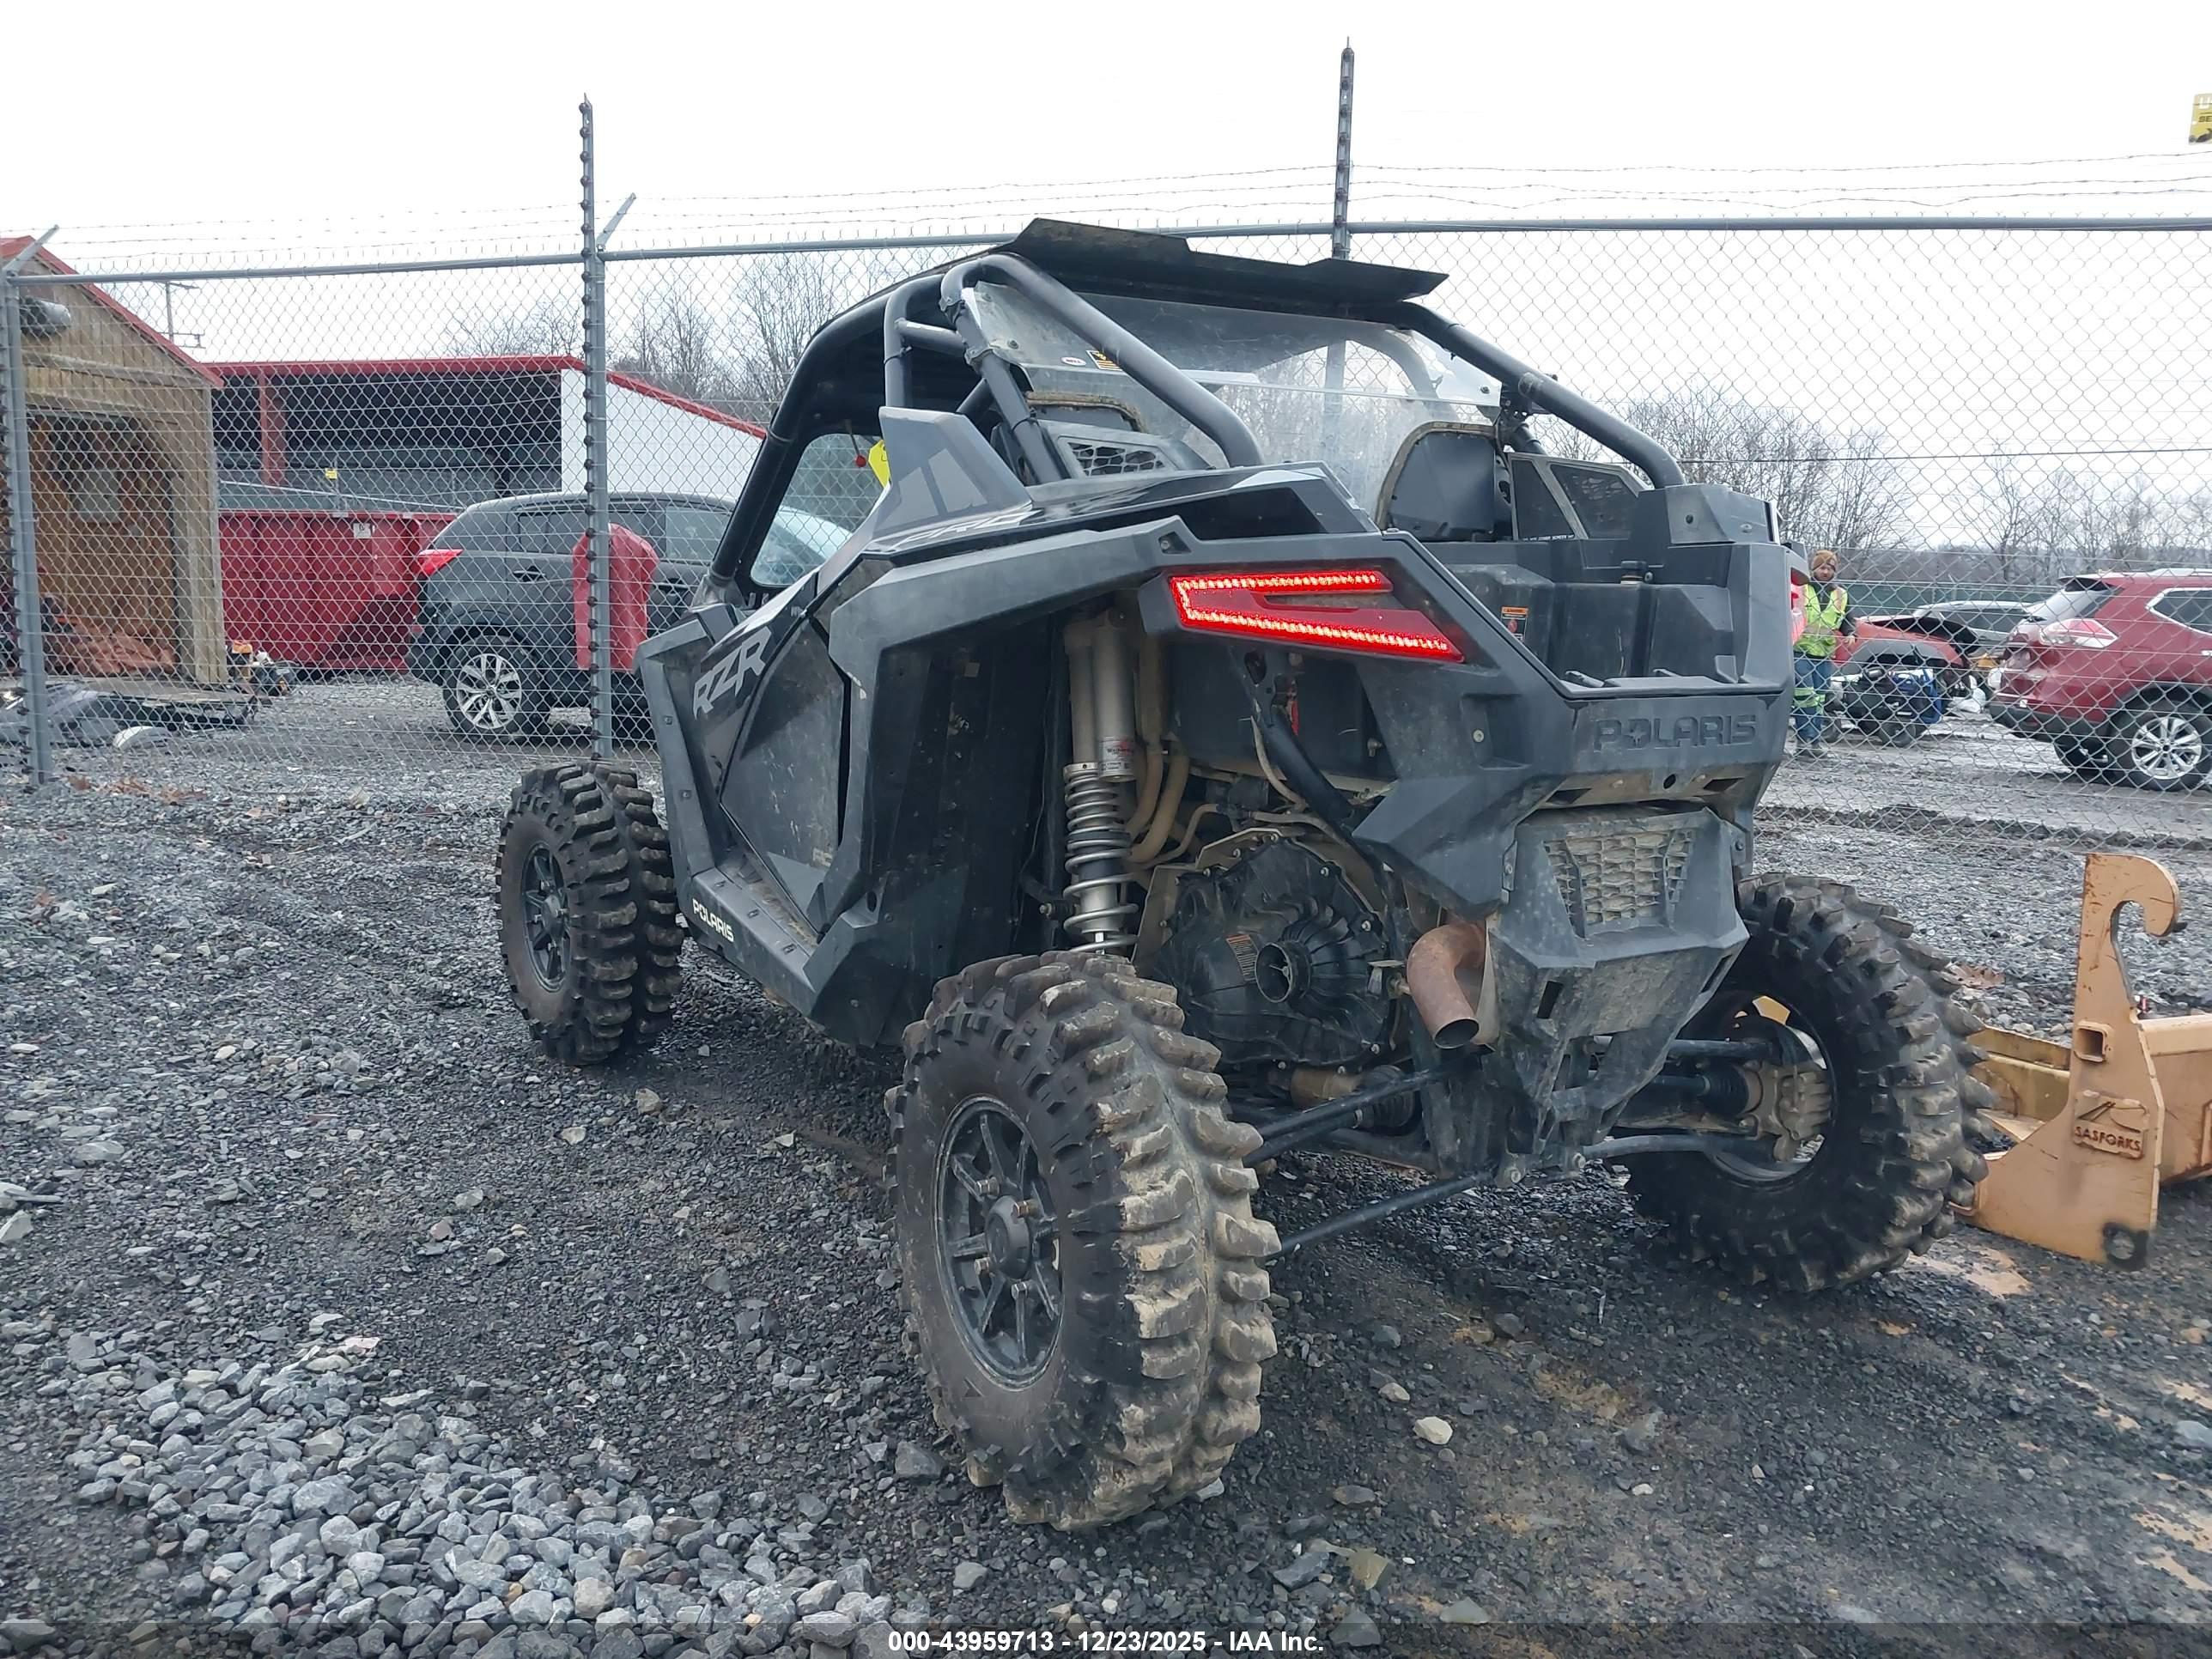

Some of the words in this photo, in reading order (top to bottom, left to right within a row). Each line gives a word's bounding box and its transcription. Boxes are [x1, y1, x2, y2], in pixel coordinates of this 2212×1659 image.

[693, 626, 772, 720] RZR
[1593, 714, 1757, 752] POLARIS
[692, 897, 734, 943] POLARIS
[2074, 1126, 2141, 1152] SASFORKS
